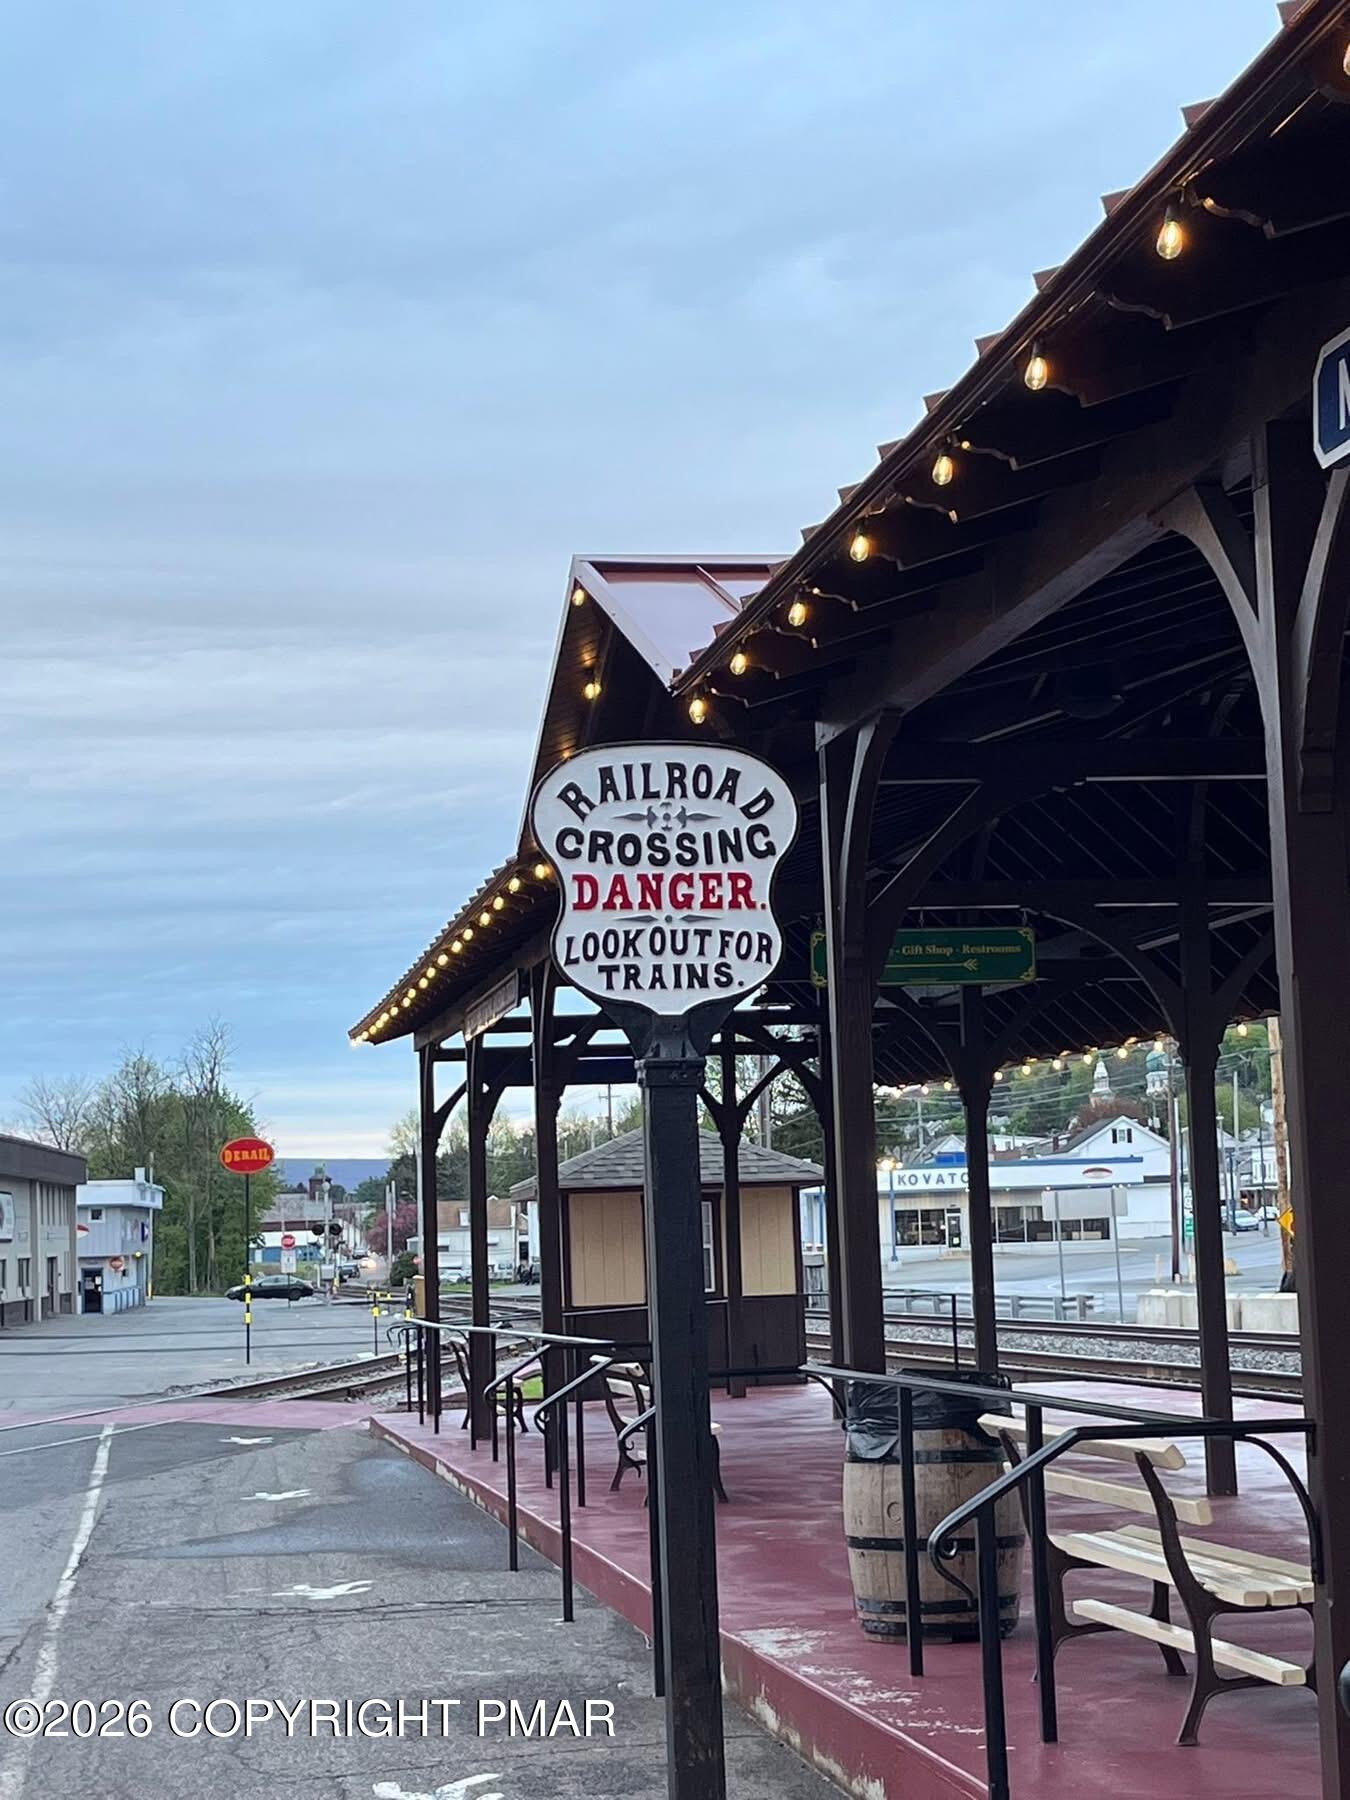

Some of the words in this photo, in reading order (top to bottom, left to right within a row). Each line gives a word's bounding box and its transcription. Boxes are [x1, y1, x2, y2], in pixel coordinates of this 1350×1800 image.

[557, 762, 775, 823] RAILROAD
[555, 823, 777, 868] CROSSING
[572, 872, 767, 911] DANGER.
[718, 929, 773, 966] FOR
[902, 945, 923, 956] Gift
[925, 944, 954, 957] Shop
[962, 943, 1022, 955] Restrooms
[597, 961, 745, 991] TRAINS.
[224, 1147, 271, 1164] DERAIL
